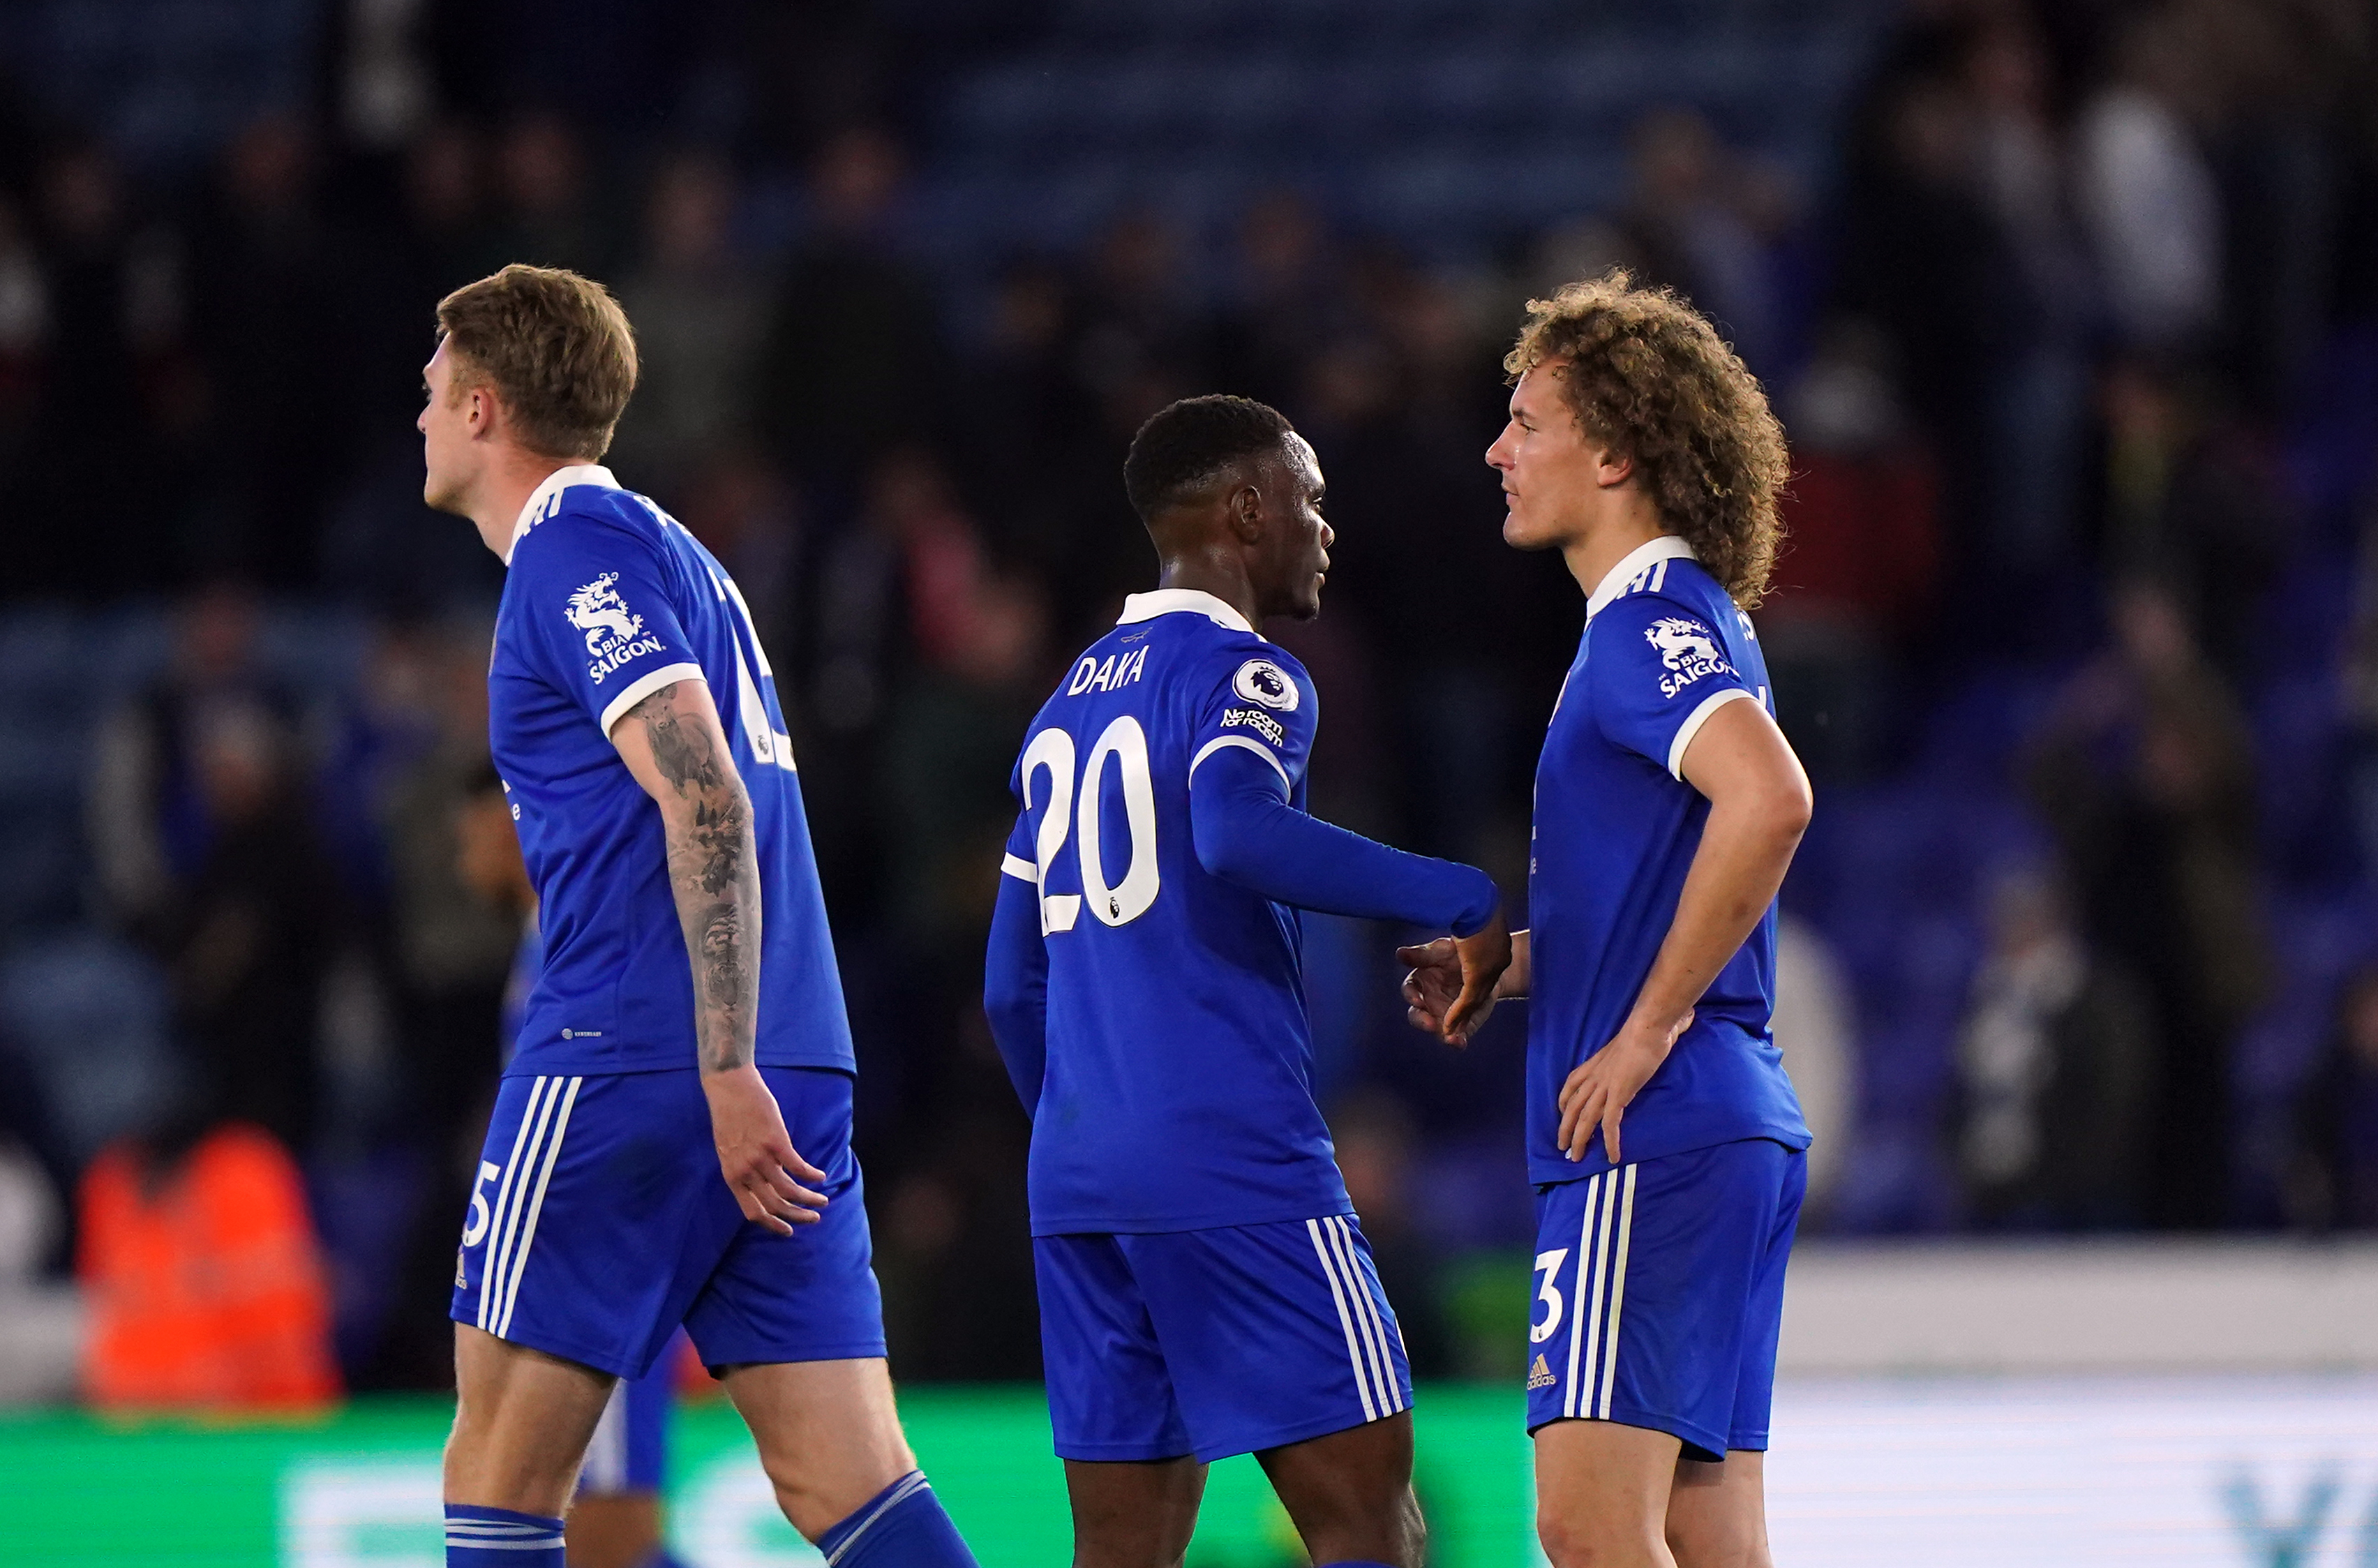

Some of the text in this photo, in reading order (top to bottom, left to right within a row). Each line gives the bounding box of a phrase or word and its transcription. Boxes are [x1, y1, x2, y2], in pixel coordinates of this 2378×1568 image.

[589, 636, 662, 685] SAIGON
[601, 634, 628, 653] BIA
[1067, 645, 1150, 696] DAKA
[1220, 717, 1243, 727] for
[1222, 708, 1283, 736] No room
[1021, 715, 1160, 938] 20
[461, 1159, 501, 1248] 5
[1530, 1248, 1569, 1344] 3
[1527, 1372, 1557, 1391] adidas
